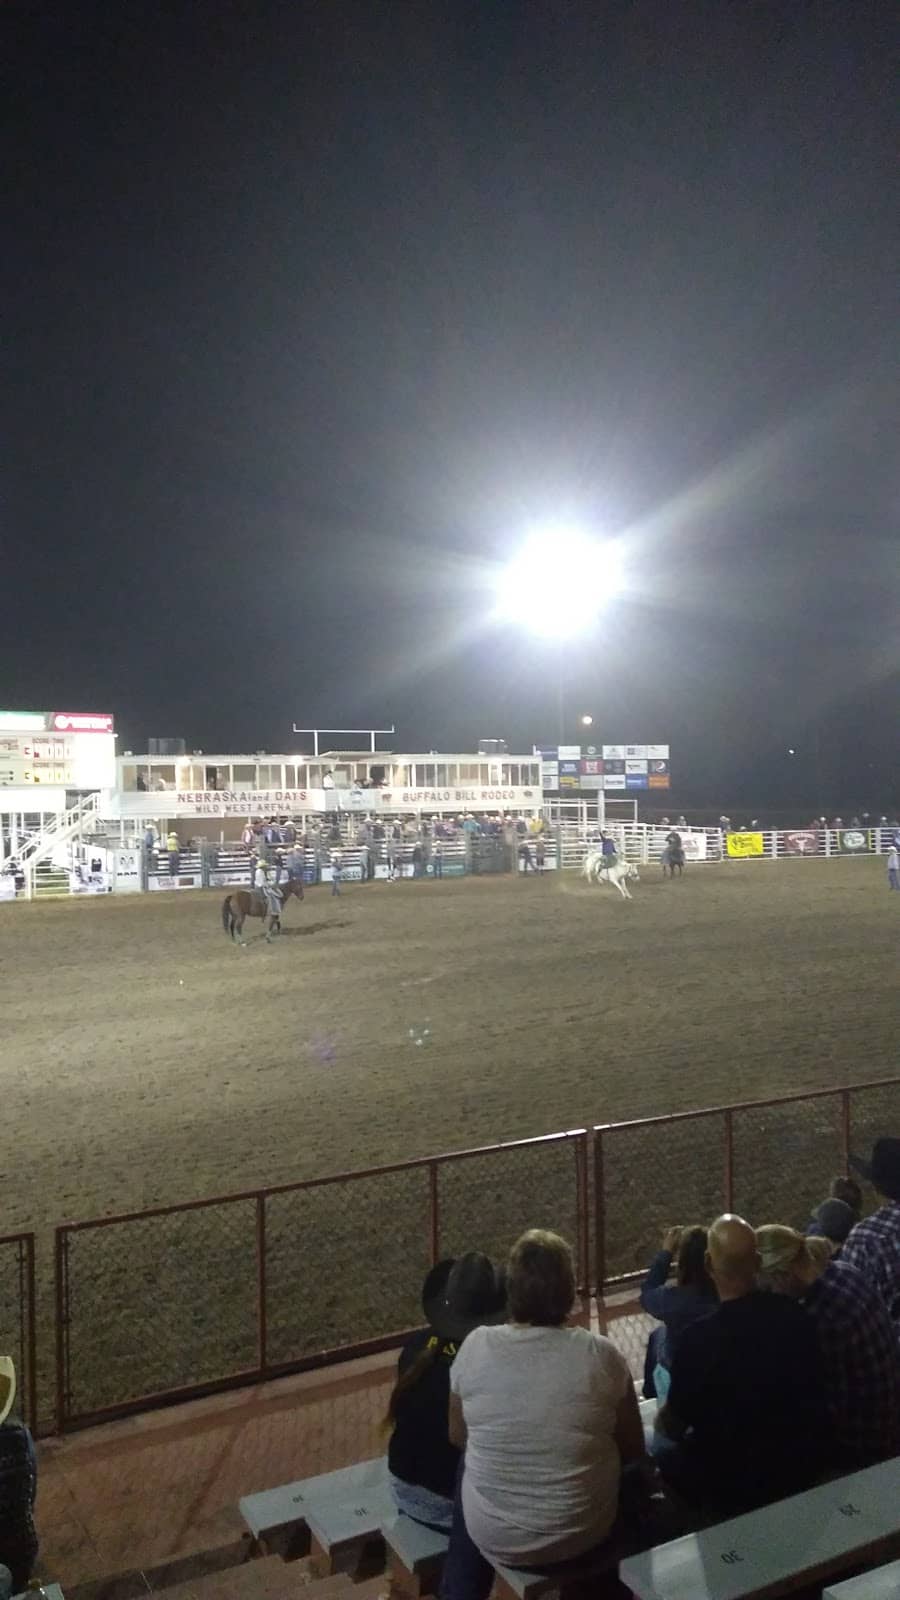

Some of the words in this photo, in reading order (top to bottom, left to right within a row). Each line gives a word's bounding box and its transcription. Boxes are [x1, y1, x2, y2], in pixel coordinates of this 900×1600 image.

[275, 791, 307, 801] DAYS
[402, 791, 450, 802] BUFFALO
[455, 791, 477, 801] BILL
[481, 790, 515, 800] RODEO
[195, 804, 220, 813] WILD
[225, 804, 251, 812] WEST
[256, 803, 291, 812] ARENA
